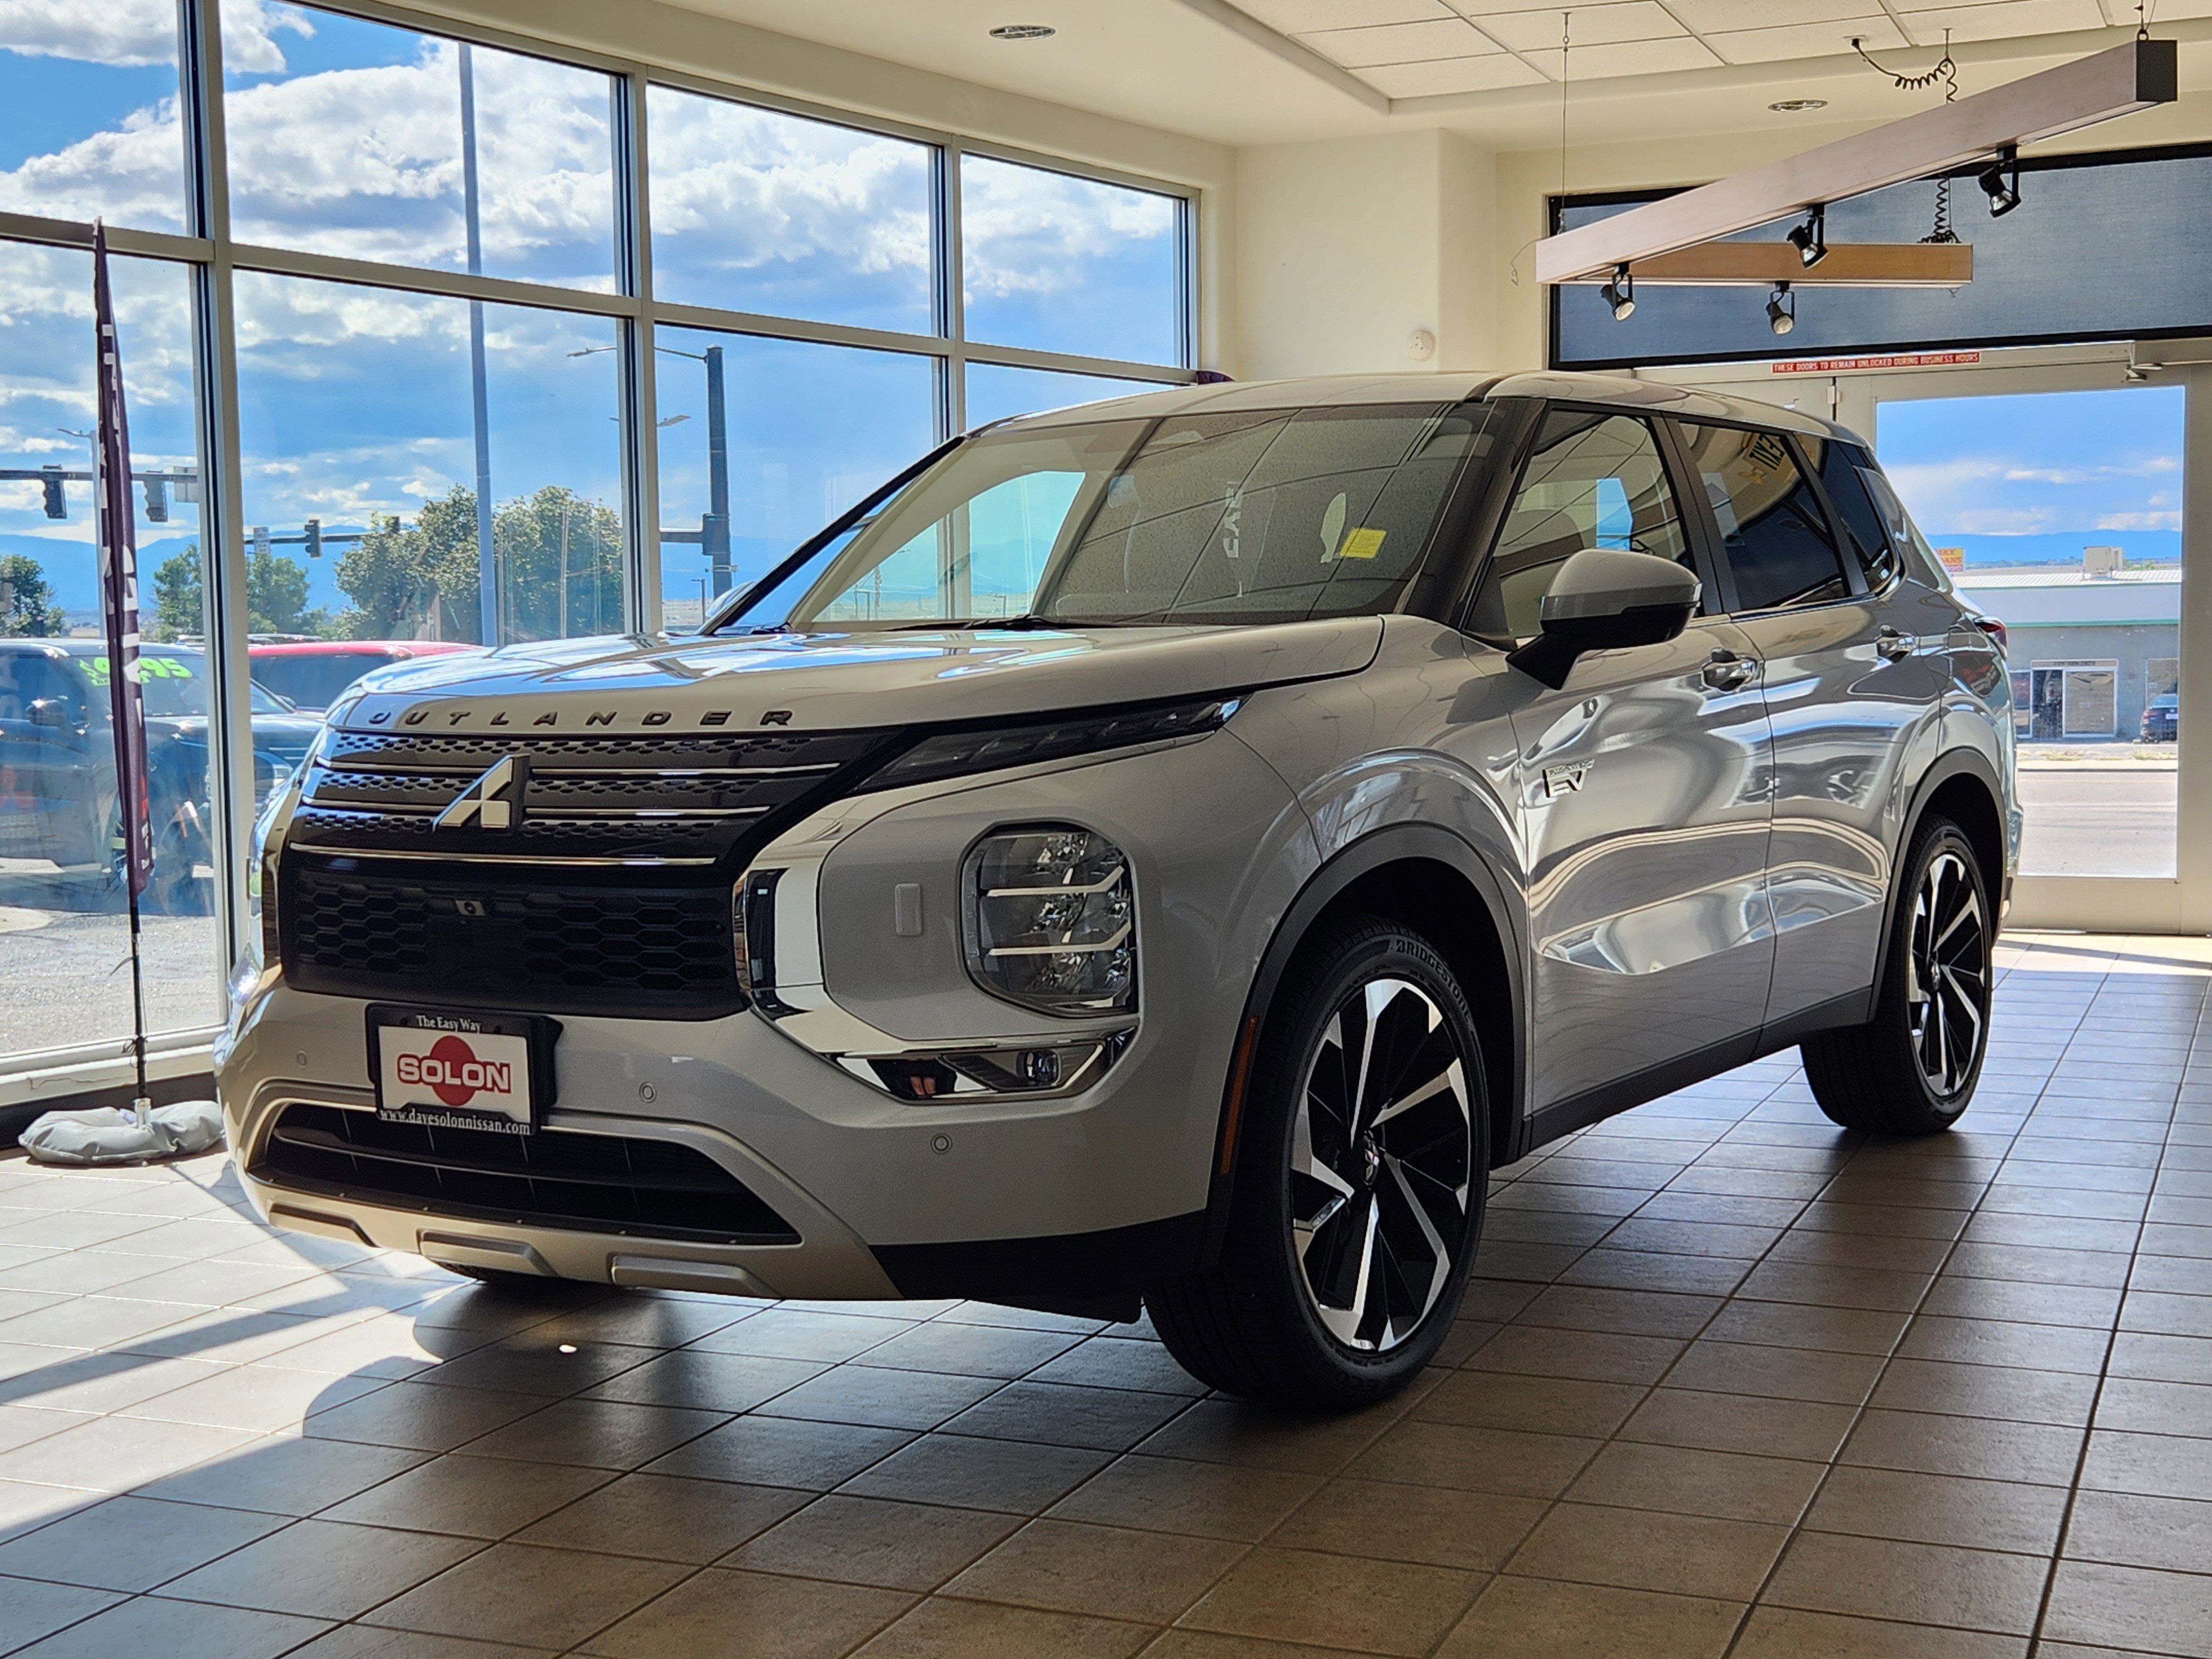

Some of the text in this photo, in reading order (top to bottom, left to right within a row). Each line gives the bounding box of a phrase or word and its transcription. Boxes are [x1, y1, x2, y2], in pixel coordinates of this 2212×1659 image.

[1773, 363, 1793, 372] THESE
[1796, 362, 1818, 371] DOORS
[1830, 360, 1855, 370] REMAIN
[1858, 358, 1892, 368] UNLOCKED
[1893, 357, 1918, 366] DURING
[1921, 354, 1954, 365] BUSINESS
[1955, 353, 1978, 363] HOURS
[368, 710, 793, 726] OUTLANDER
[1542, 768, 1587, 798] EV
[1395, 939, 1470, 1024] BRIDGESTONE
[416, 1015, 482, 1034] The Easy Way
[397, 1053, 512, 1094] SOLON
[379, 1108, 531, 1136] www.davesolonnissan.com
